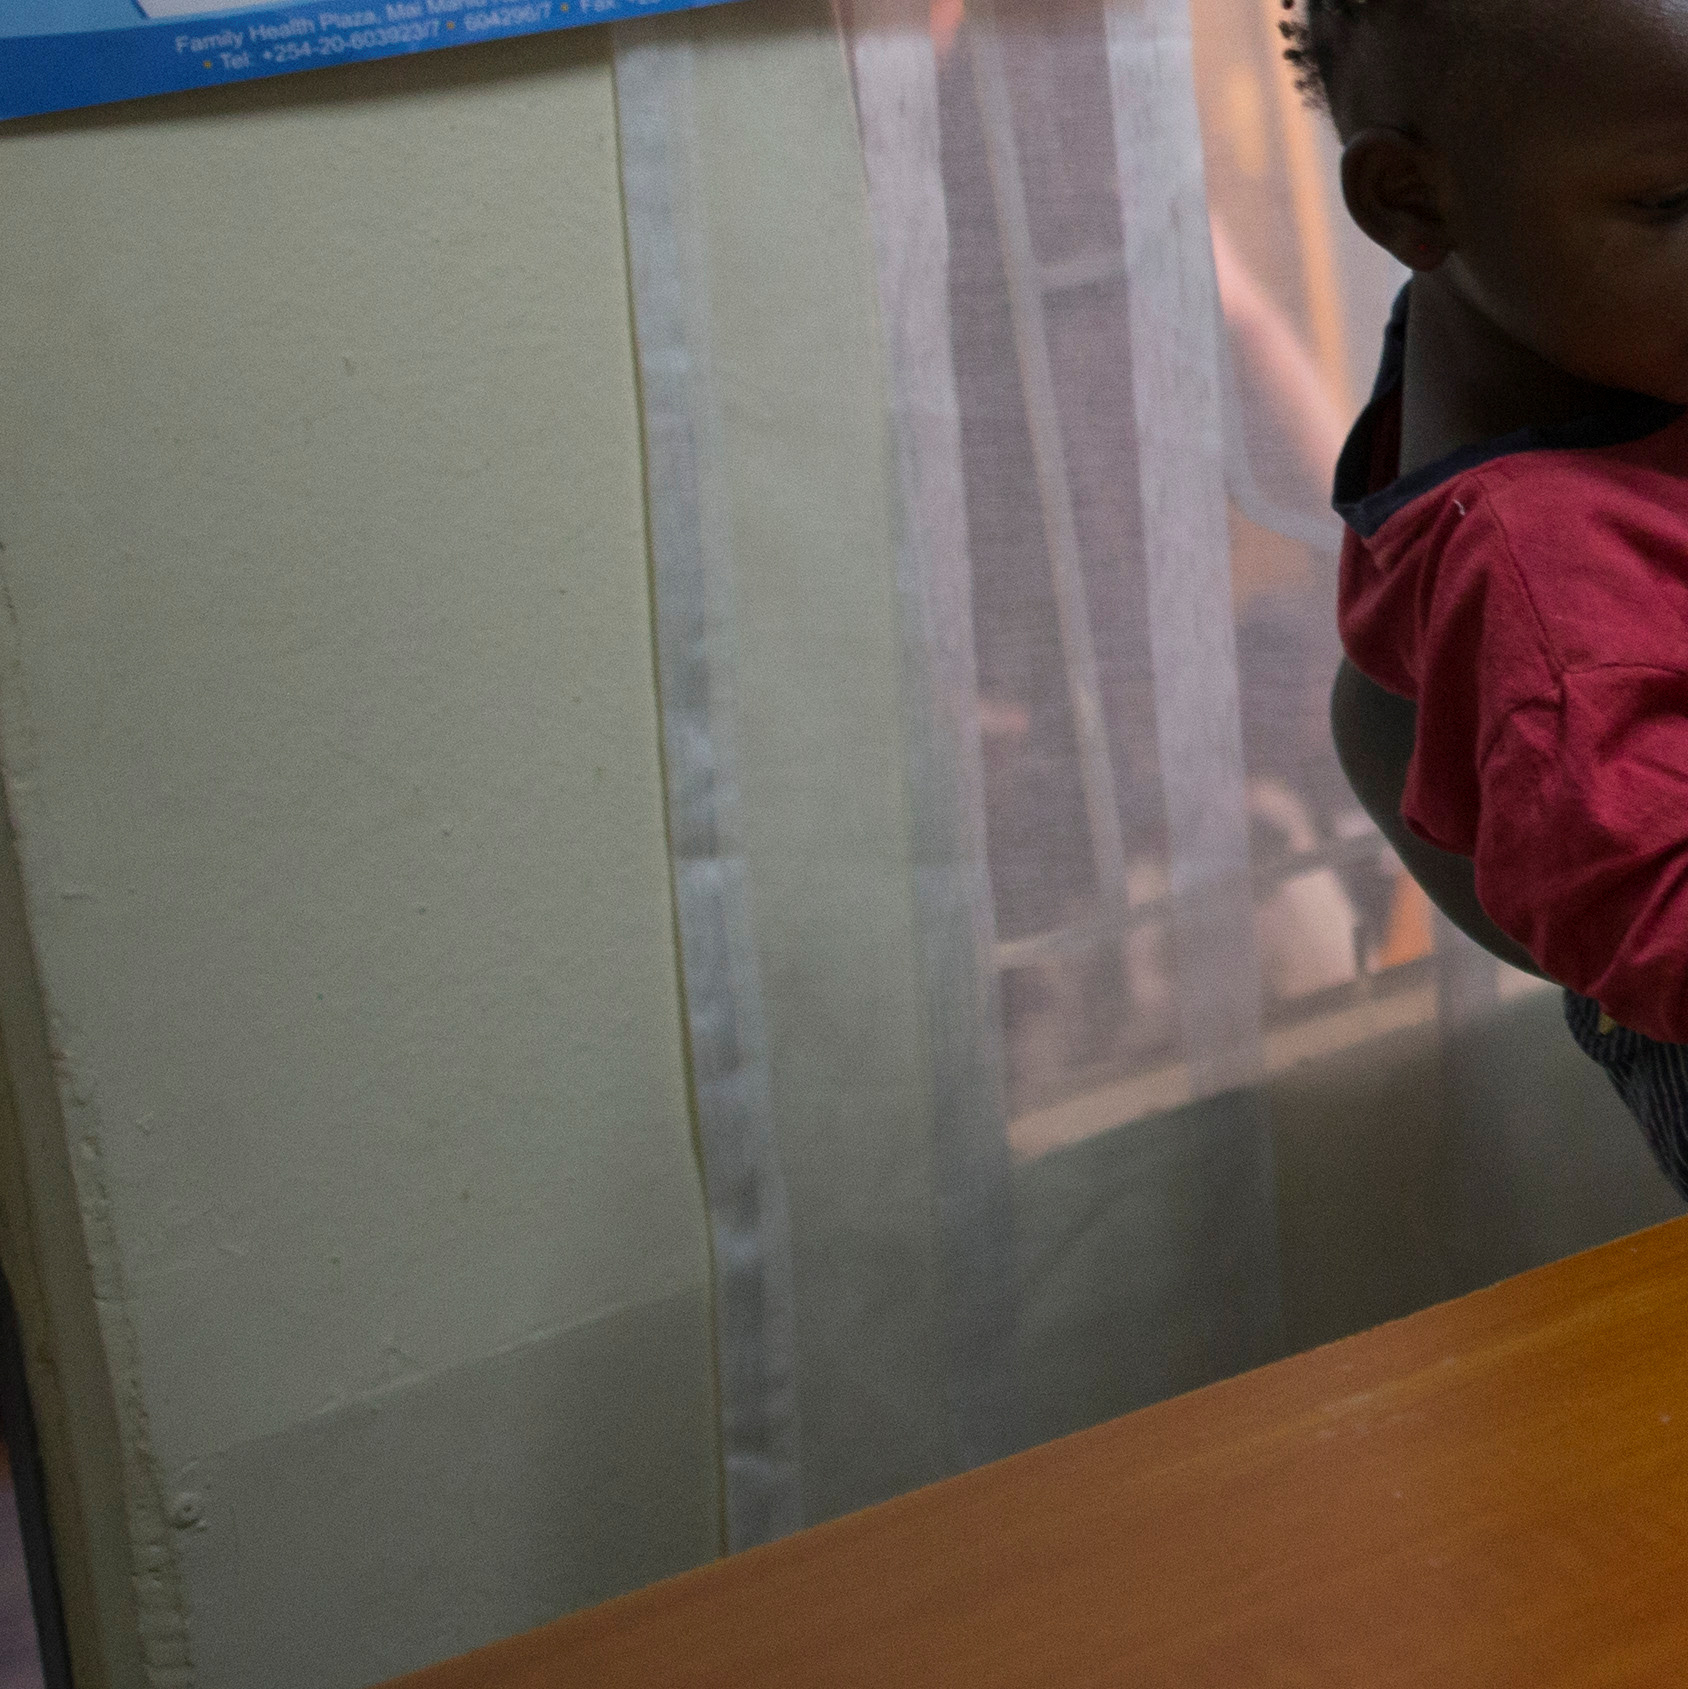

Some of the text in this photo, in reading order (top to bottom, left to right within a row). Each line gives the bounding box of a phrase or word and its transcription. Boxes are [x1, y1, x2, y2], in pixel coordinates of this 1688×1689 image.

[174, 30, 244, 55] Family
[248, 16, 316, 42] Health
[385, 2, 422, 22] Mai
